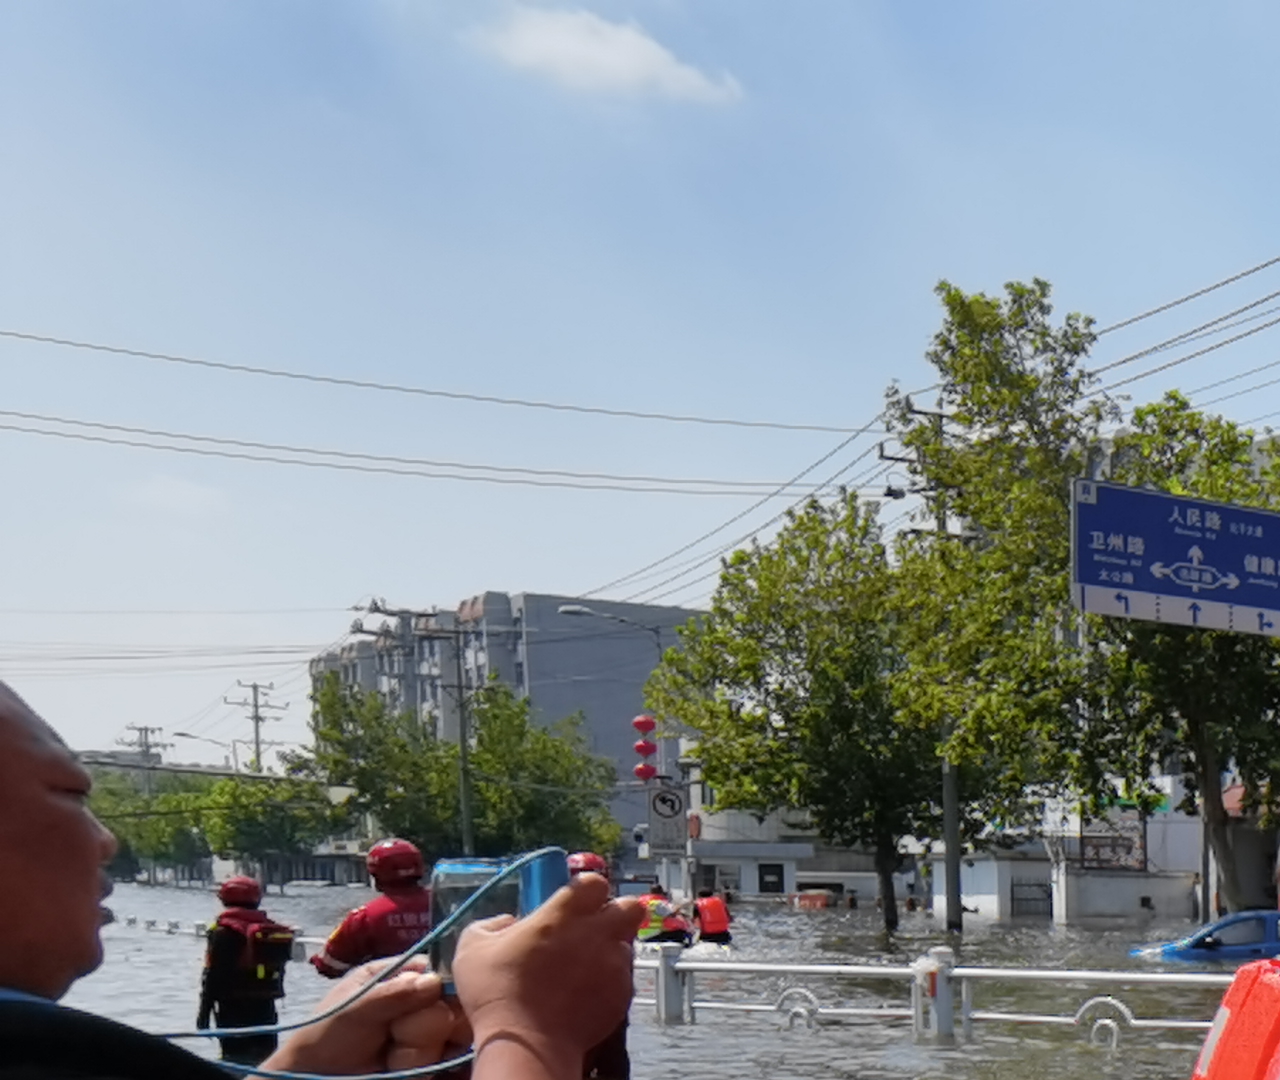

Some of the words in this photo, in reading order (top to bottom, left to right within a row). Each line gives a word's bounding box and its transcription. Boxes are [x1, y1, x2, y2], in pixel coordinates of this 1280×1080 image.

[1168, 506, 1221, 530] 人民路
[1087, 531, 1145, 556] 卫州路
